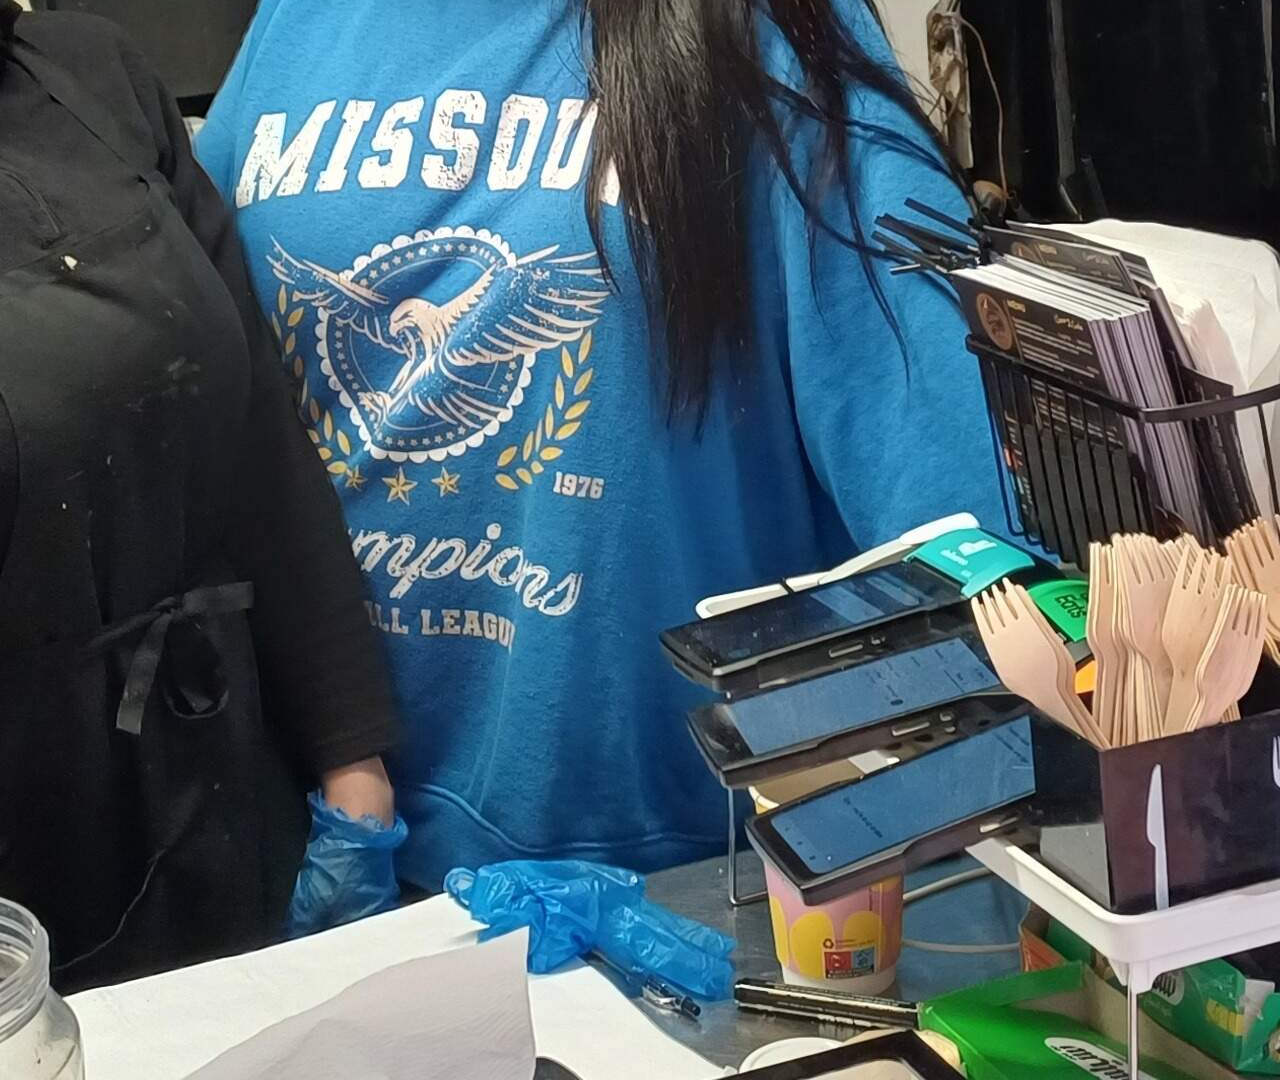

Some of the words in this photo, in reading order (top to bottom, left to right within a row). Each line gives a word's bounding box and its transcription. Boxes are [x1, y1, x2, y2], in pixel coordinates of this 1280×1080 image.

[235, 88, 622, 209] MISSOU
[553, 471, 605, 499] 1976
[348, 523, 585, 617] mpions
[1054, 592, 1086, 619] Eats
[420, 608, 517, 654] LEAGU
